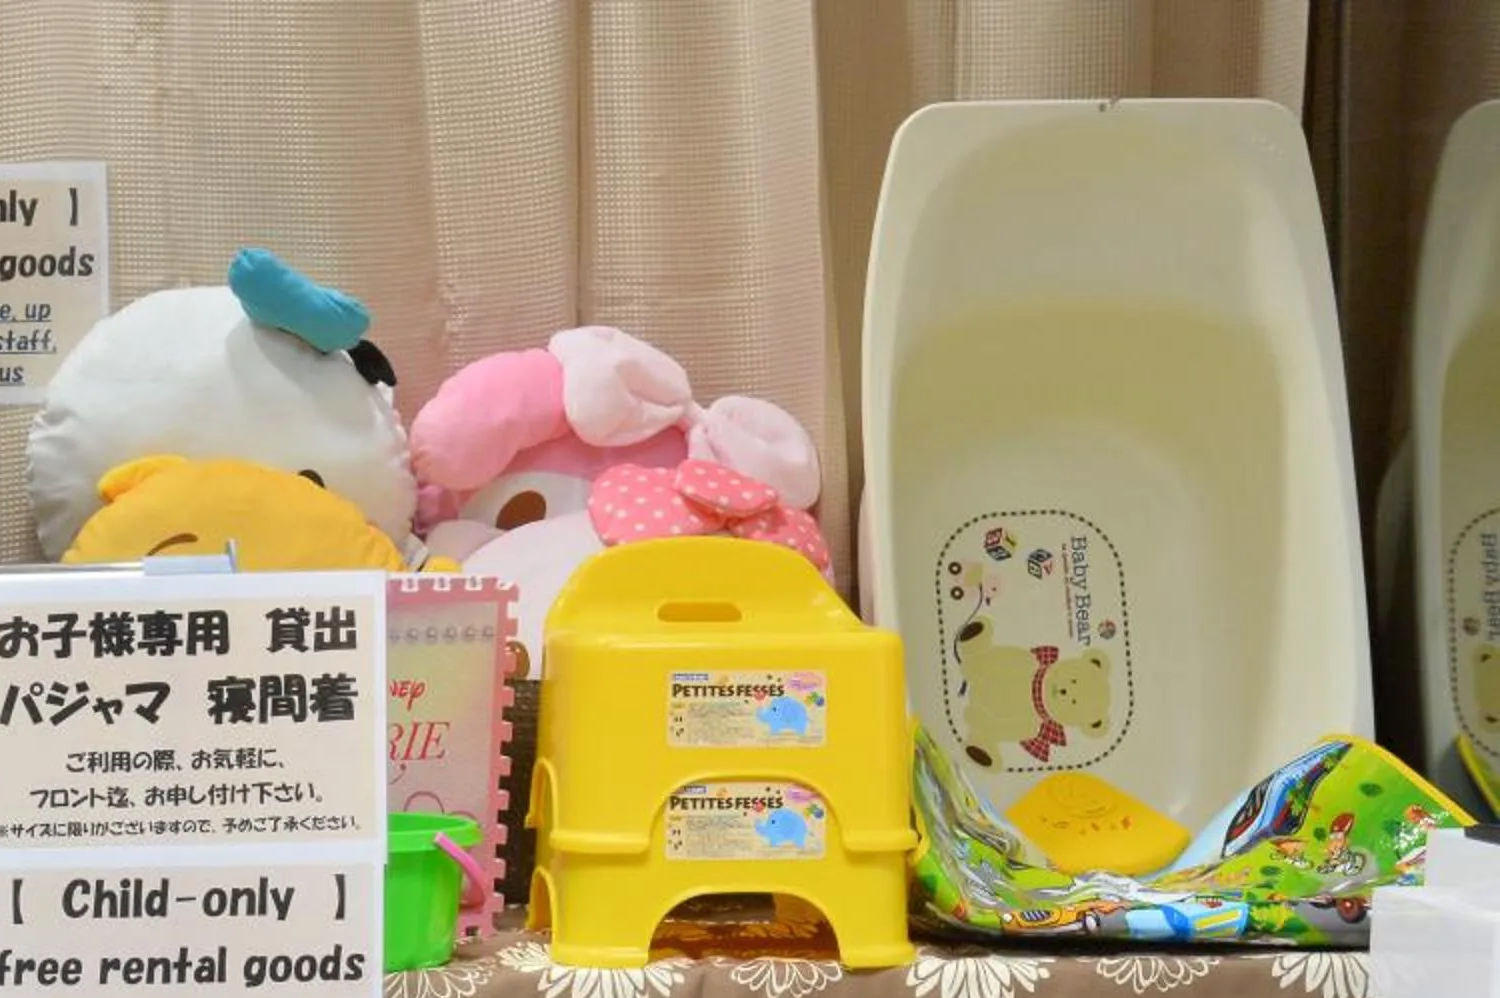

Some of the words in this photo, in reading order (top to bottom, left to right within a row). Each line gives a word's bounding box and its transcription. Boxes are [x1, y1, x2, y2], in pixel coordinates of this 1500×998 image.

[25, 303, 52, 321] up
[1070, 536, 1088, 591] Baby
[264, 606, 357, 653] 貸出
[1075, 594, 1092, 646] Bear
[0, 681, 171, 726] パジャマ
[207, 672, 359, 725] 寝間着
[62, 876, 295, 921] Child-only
[99, 946, 227, 985] rental
[243, 943, 366, 988] goods
